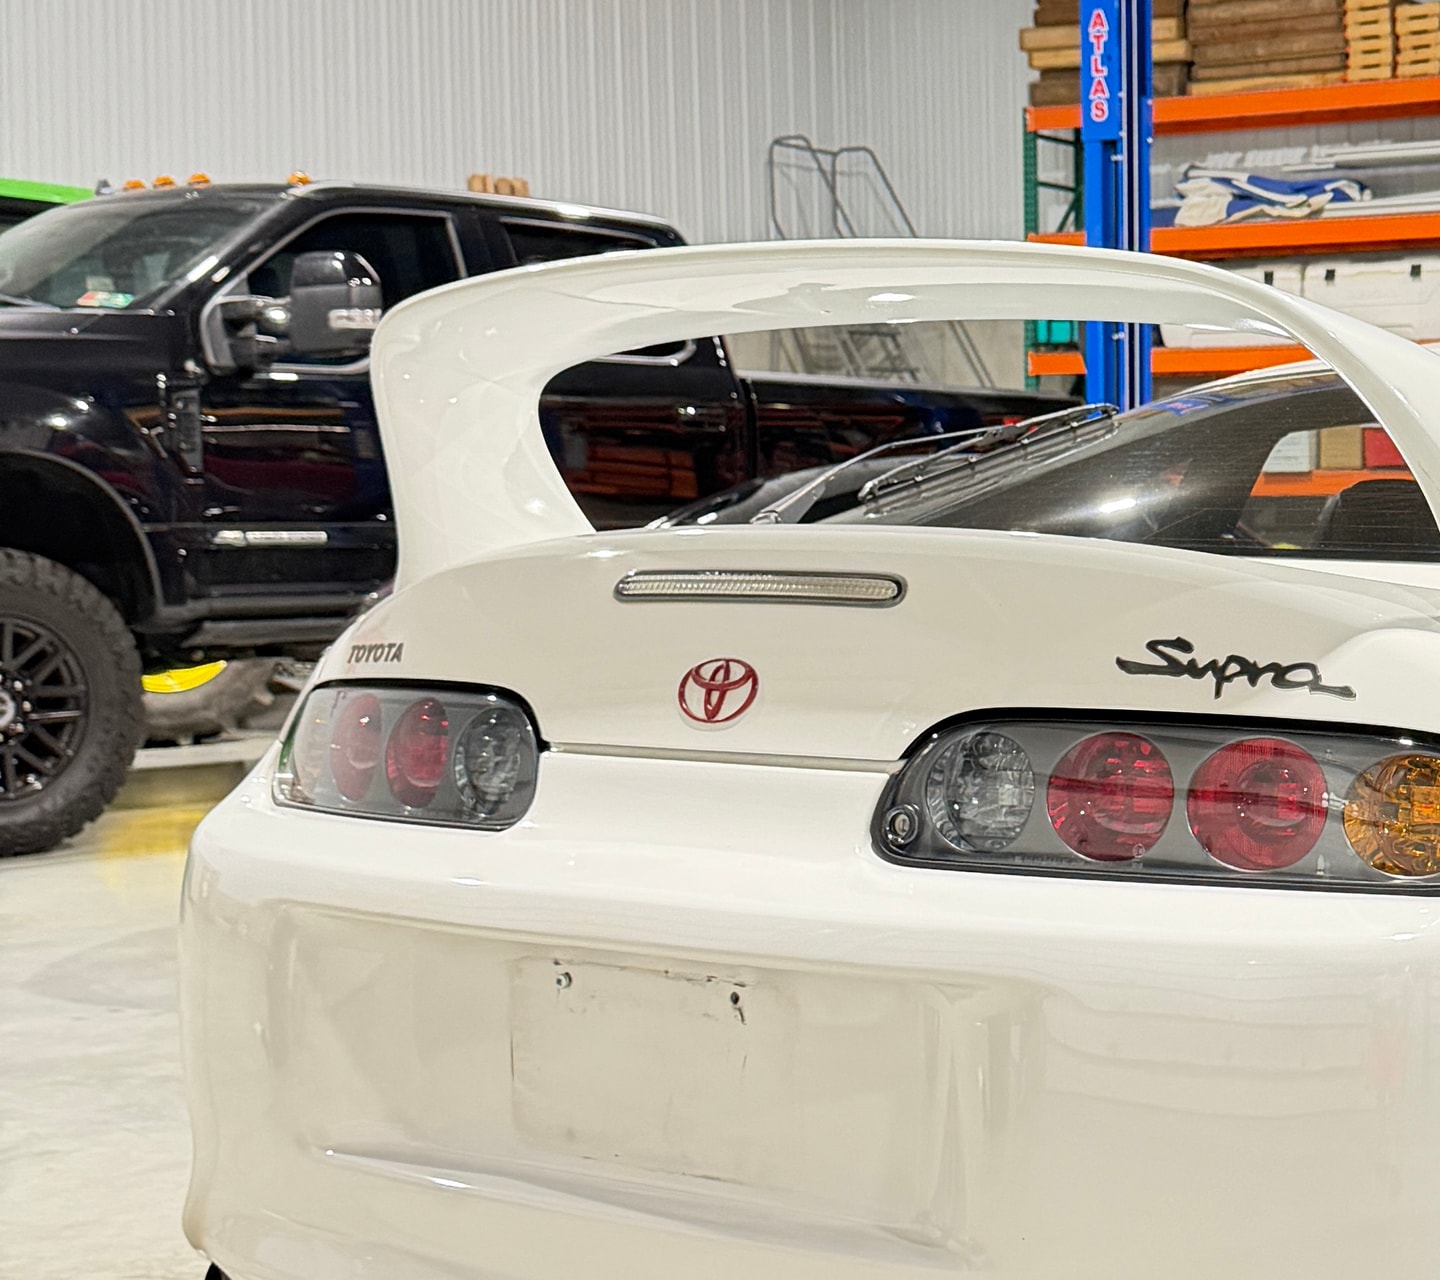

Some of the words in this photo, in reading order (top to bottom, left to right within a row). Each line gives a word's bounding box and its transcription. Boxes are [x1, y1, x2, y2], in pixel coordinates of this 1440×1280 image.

[1088, 8, 1110, 122] ATLAS
[347, 642, 404, 664] TOYOTA
[1115, 636, 1357, 700] Supra
